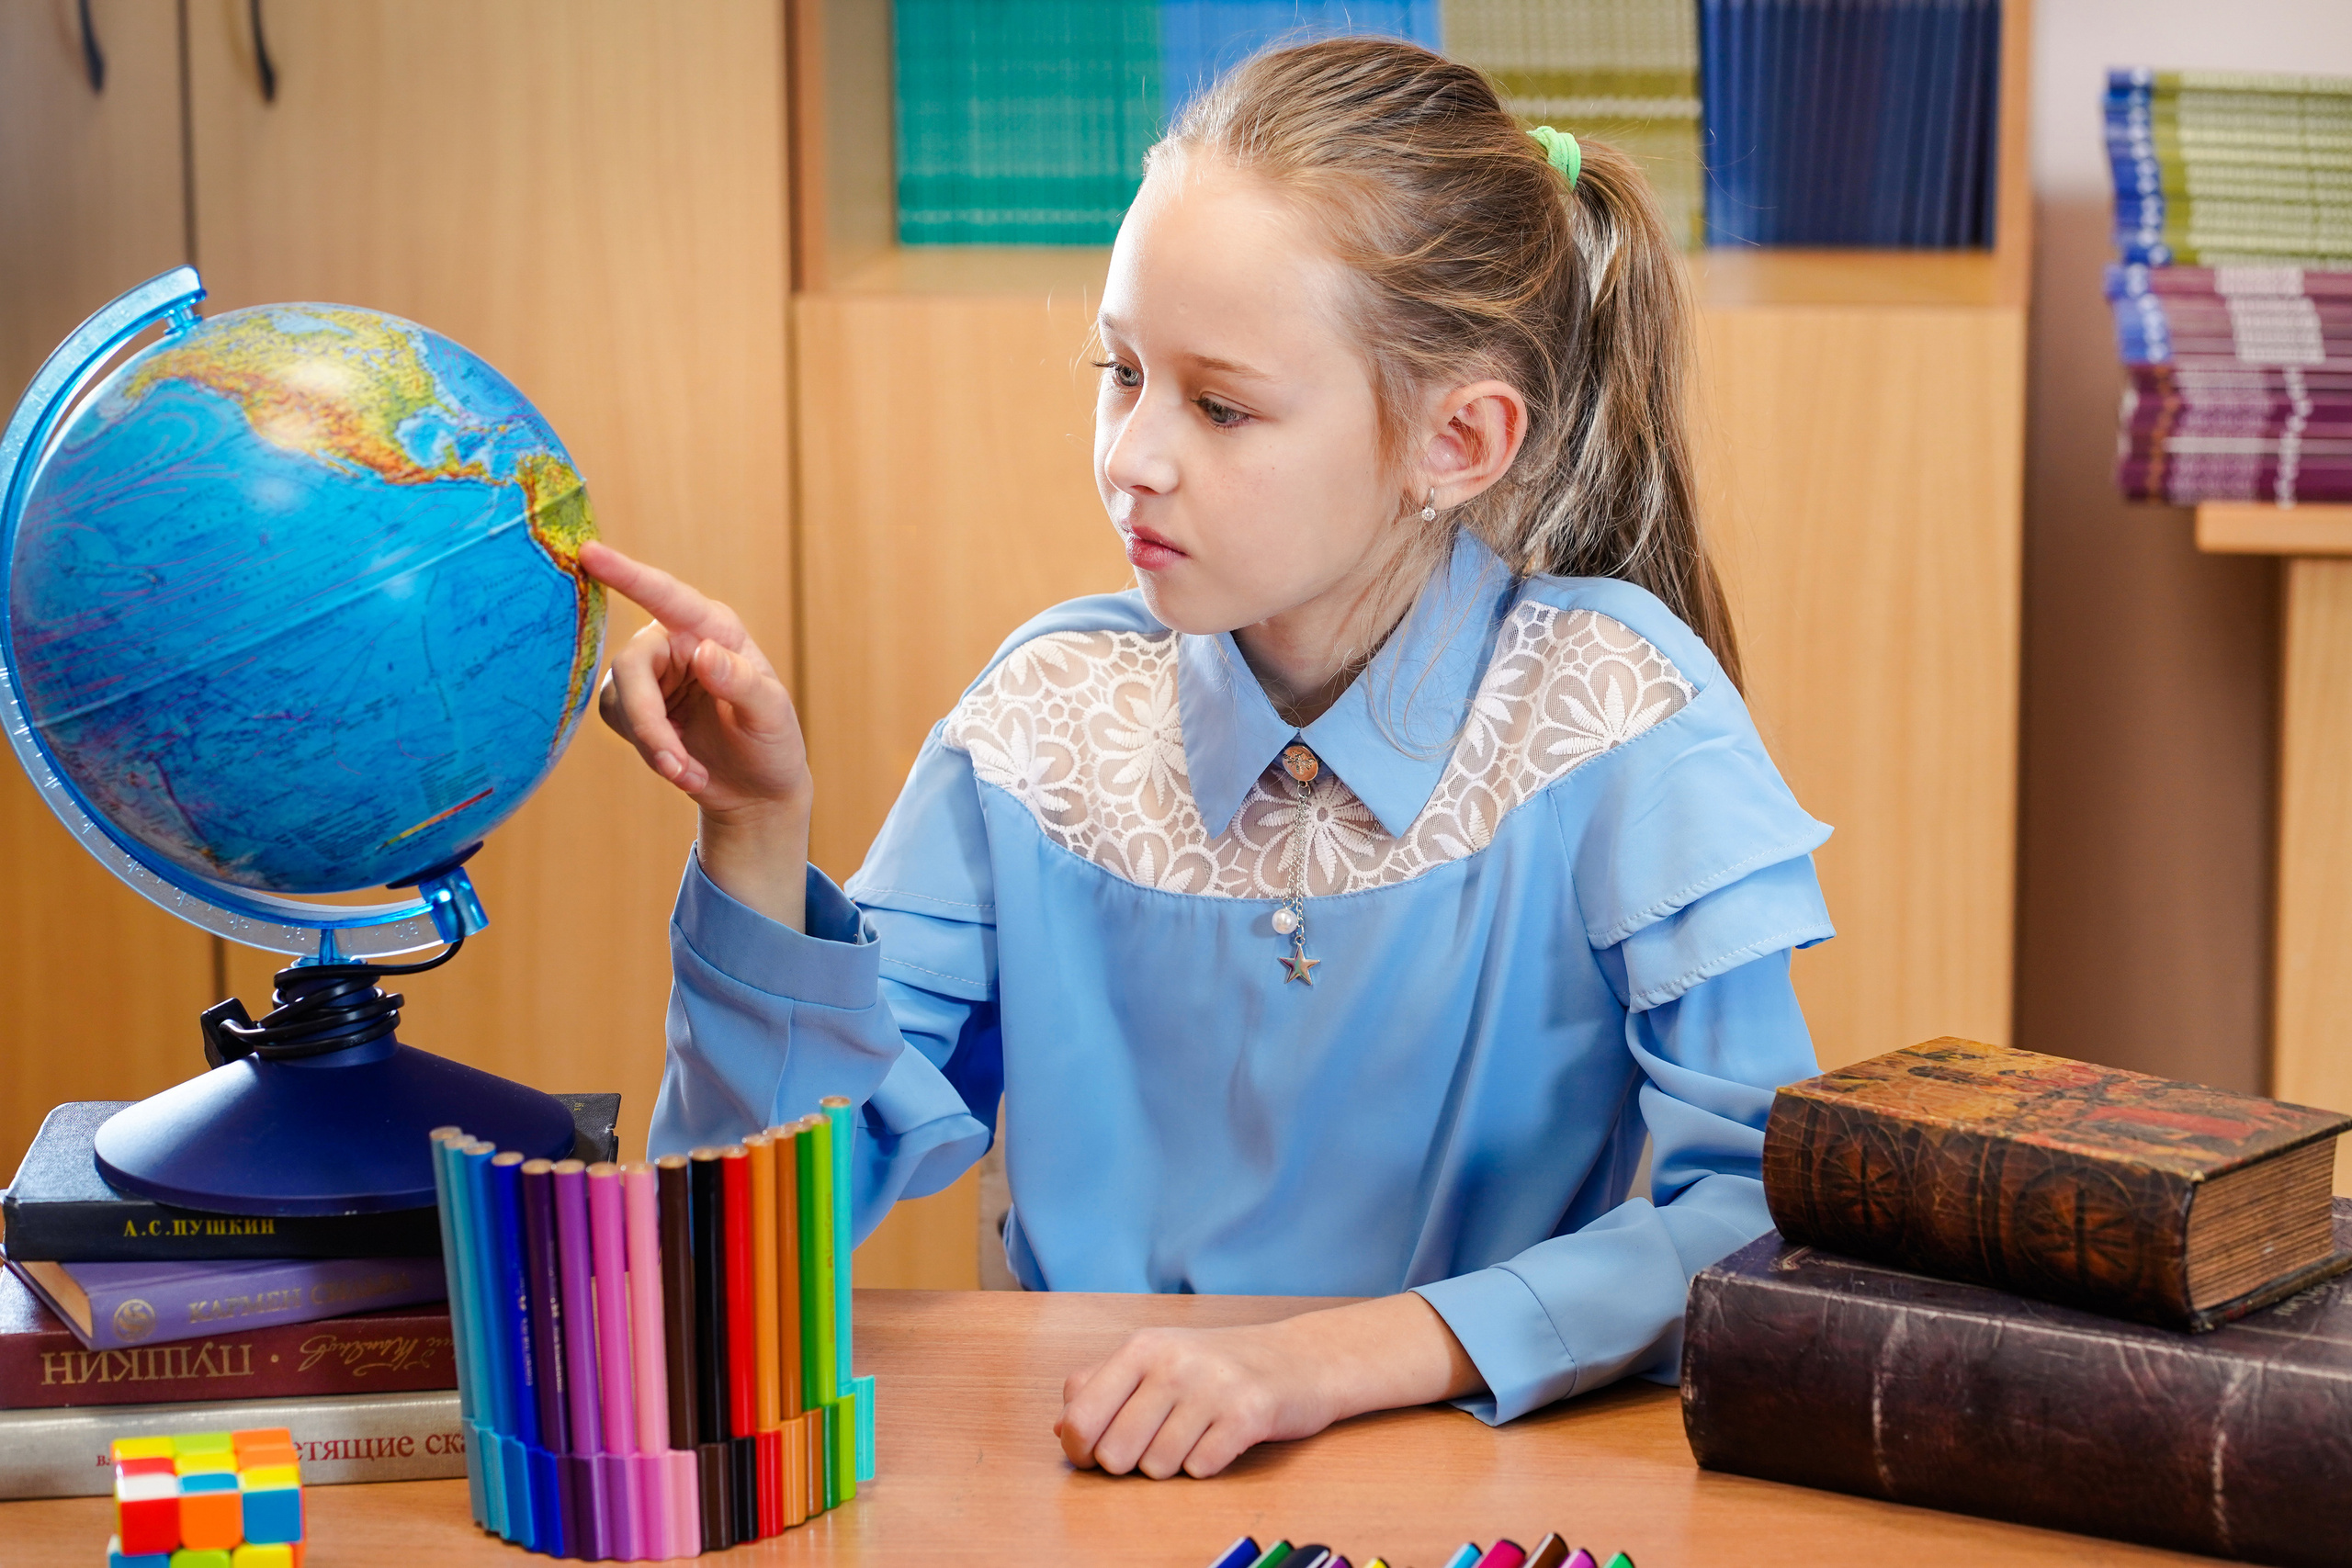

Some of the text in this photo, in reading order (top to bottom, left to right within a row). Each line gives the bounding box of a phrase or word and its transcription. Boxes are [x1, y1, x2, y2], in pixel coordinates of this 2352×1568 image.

[187, 1288, 301, 1324] КАРМЕН
[40, 1341, 255, 1386] ПУШКИН
[425, 1433, 465, 1455] ск
